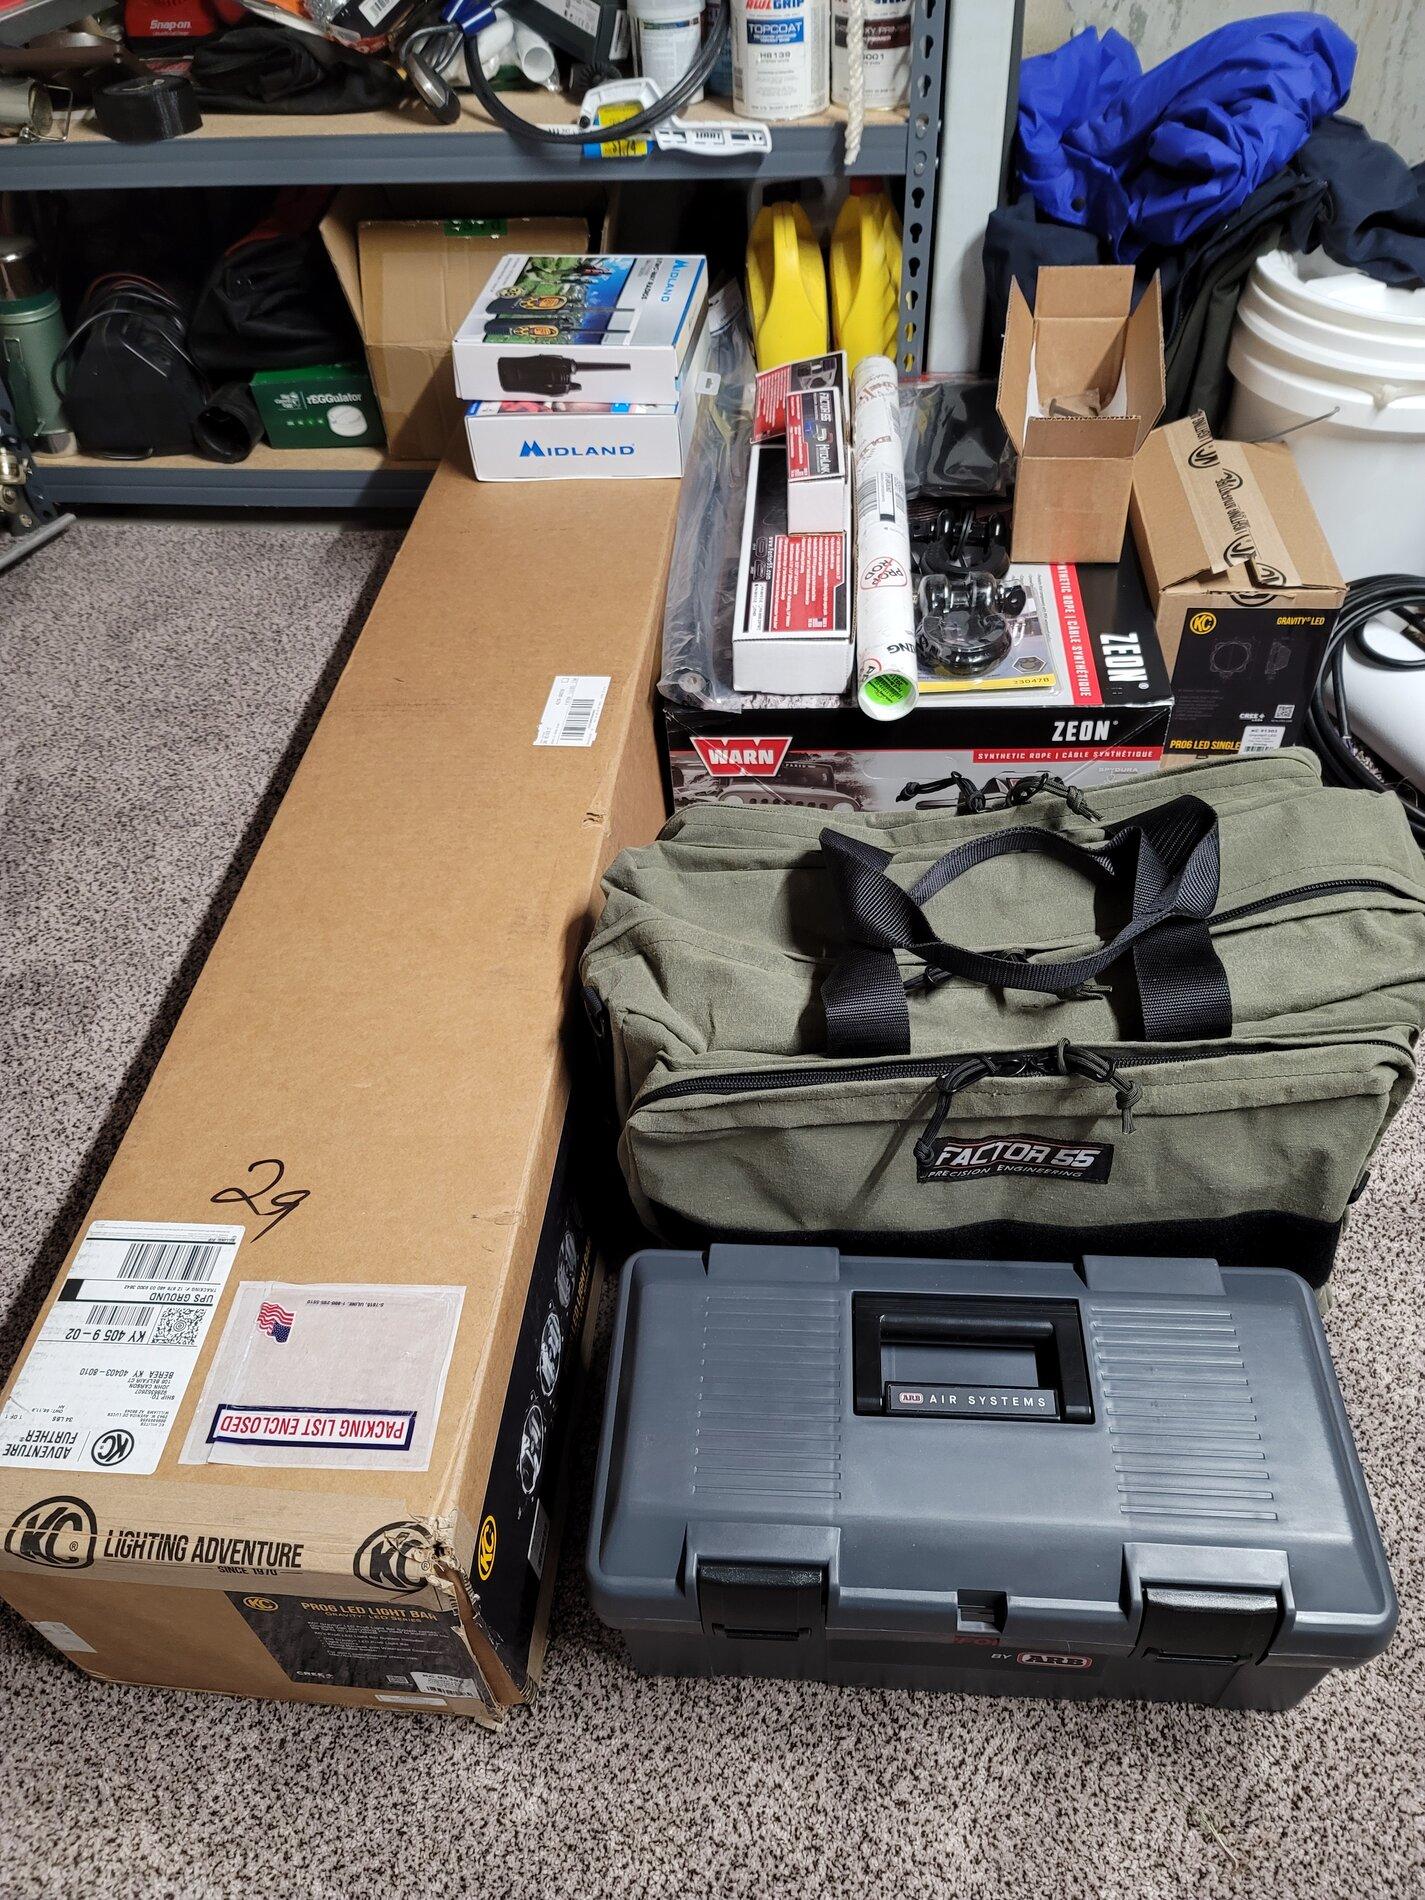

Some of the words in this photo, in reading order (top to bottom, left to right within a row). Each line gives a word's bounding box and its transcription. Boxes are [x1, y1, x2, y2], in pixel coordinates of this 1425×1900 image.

[150, 19, 191, 31] Snap-on
[748, 22, 803, 35] TOPCOAT
[661, 259, 689, 303] MIDLAND
[306, 392, 362, 405] rEGGulator
[519, 440, 635, 458] MIDLAND
[1063, 594, 1075, 614] ROPE
[1190, 612, 1217, 634] KC
[1311, 616, 1325, 626] LED
[1100, 632, 1148, 682] ZEON
[1052, 720, 1110, 742] ZEON
[1170, 740, 1192, 749] PRO6
[1193, 740, 1210, 749] LED
[1211, 740, 1241, 750] SINGLE
[708, 749, 774, 765] WARN
[978, 752, 1026, 760] SYNTHETIC
[1029, 752, 1051, 760] ROPE
[934, 1141, 1053, 1168] FACTOR
[1050, 1149, 1102, 1168] 55
[927, 1167, 992, 1178] PRECISION
[997, 1164, 1084, 1179] ENGINEERING
[149, 1292, 192, 1302] GROUND
[194, 1294, 214, 1303] UPS
[104, 1329, 126, 1342] 405
[128, 1330, 147, 1343] KY
[133, 1370, 144, 1378] KY
[149, 1371, 175, 1379] BEREA
[902, 1394, 922, 1402] ARB
[929, 1394, 957, 1404] AIR
[968, 1395, 1047, 1408] SYSTEMS
[219, 1415, 301, 1436] ENCLOSED
[300, 1418, 336, 1438] LIST
[338, 1419, 405, 1439] PACKING
[25, 1429, 79, 1445] FURTHER
[3, 1443, 73, 1460] ADVENTURE
[97, 1434, 129, 1463] KC
[20, 1505, 83, 1565] KC
[103, 1529, 190, 1563] LIGHTING
[190, 1536, 305, 1568] ADVENTURE
[217, 1565, 250, 1576] SINCE
[340, 1604, 366, 1616] LED
[368, 1607, 407, 1619] LIGHT
[409, 1609, 439, 1622] BAR
[1025, 1654, 1085, 1667] ARB
